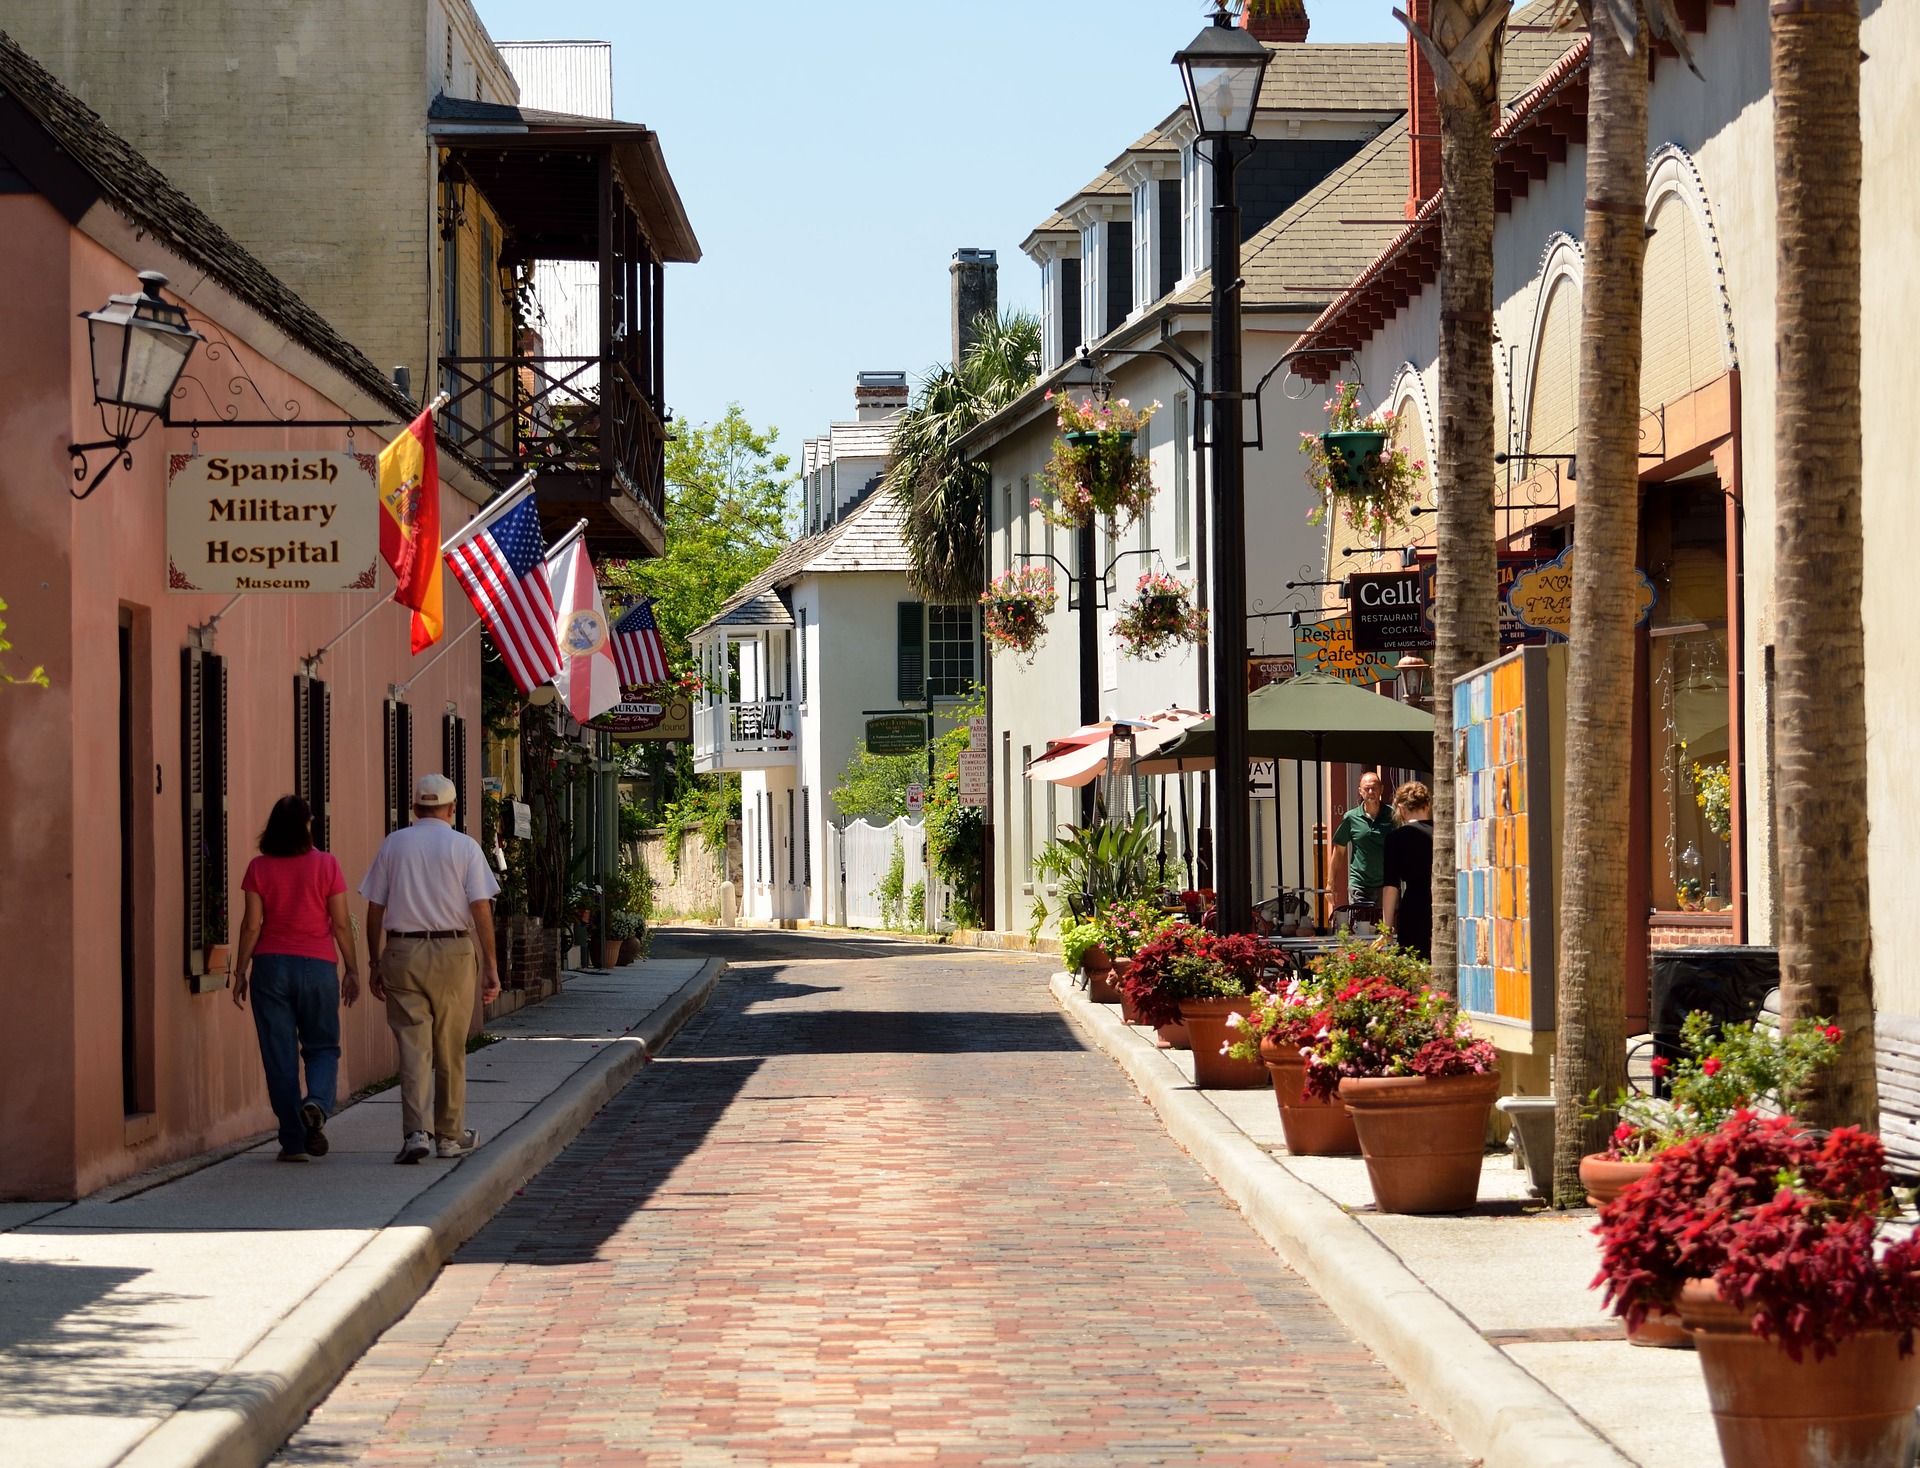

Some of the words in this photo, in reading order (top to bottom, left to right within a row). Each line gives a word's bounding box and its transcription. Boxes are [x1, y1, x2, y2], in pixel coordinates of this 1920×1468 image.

[206, 457, 339, 487] Spanish
[208, 498, 338, 528] Military
[206, 540, 340, 569] Hospital
[236, 576, 311, 590] Museum
[1361, 613, 1419, 623] RESTAURANT
[1317, 645, 1354, 662] Cafe
[1342, 667, 1370, 678] ITALY
[662, 723, 686, 732] found
